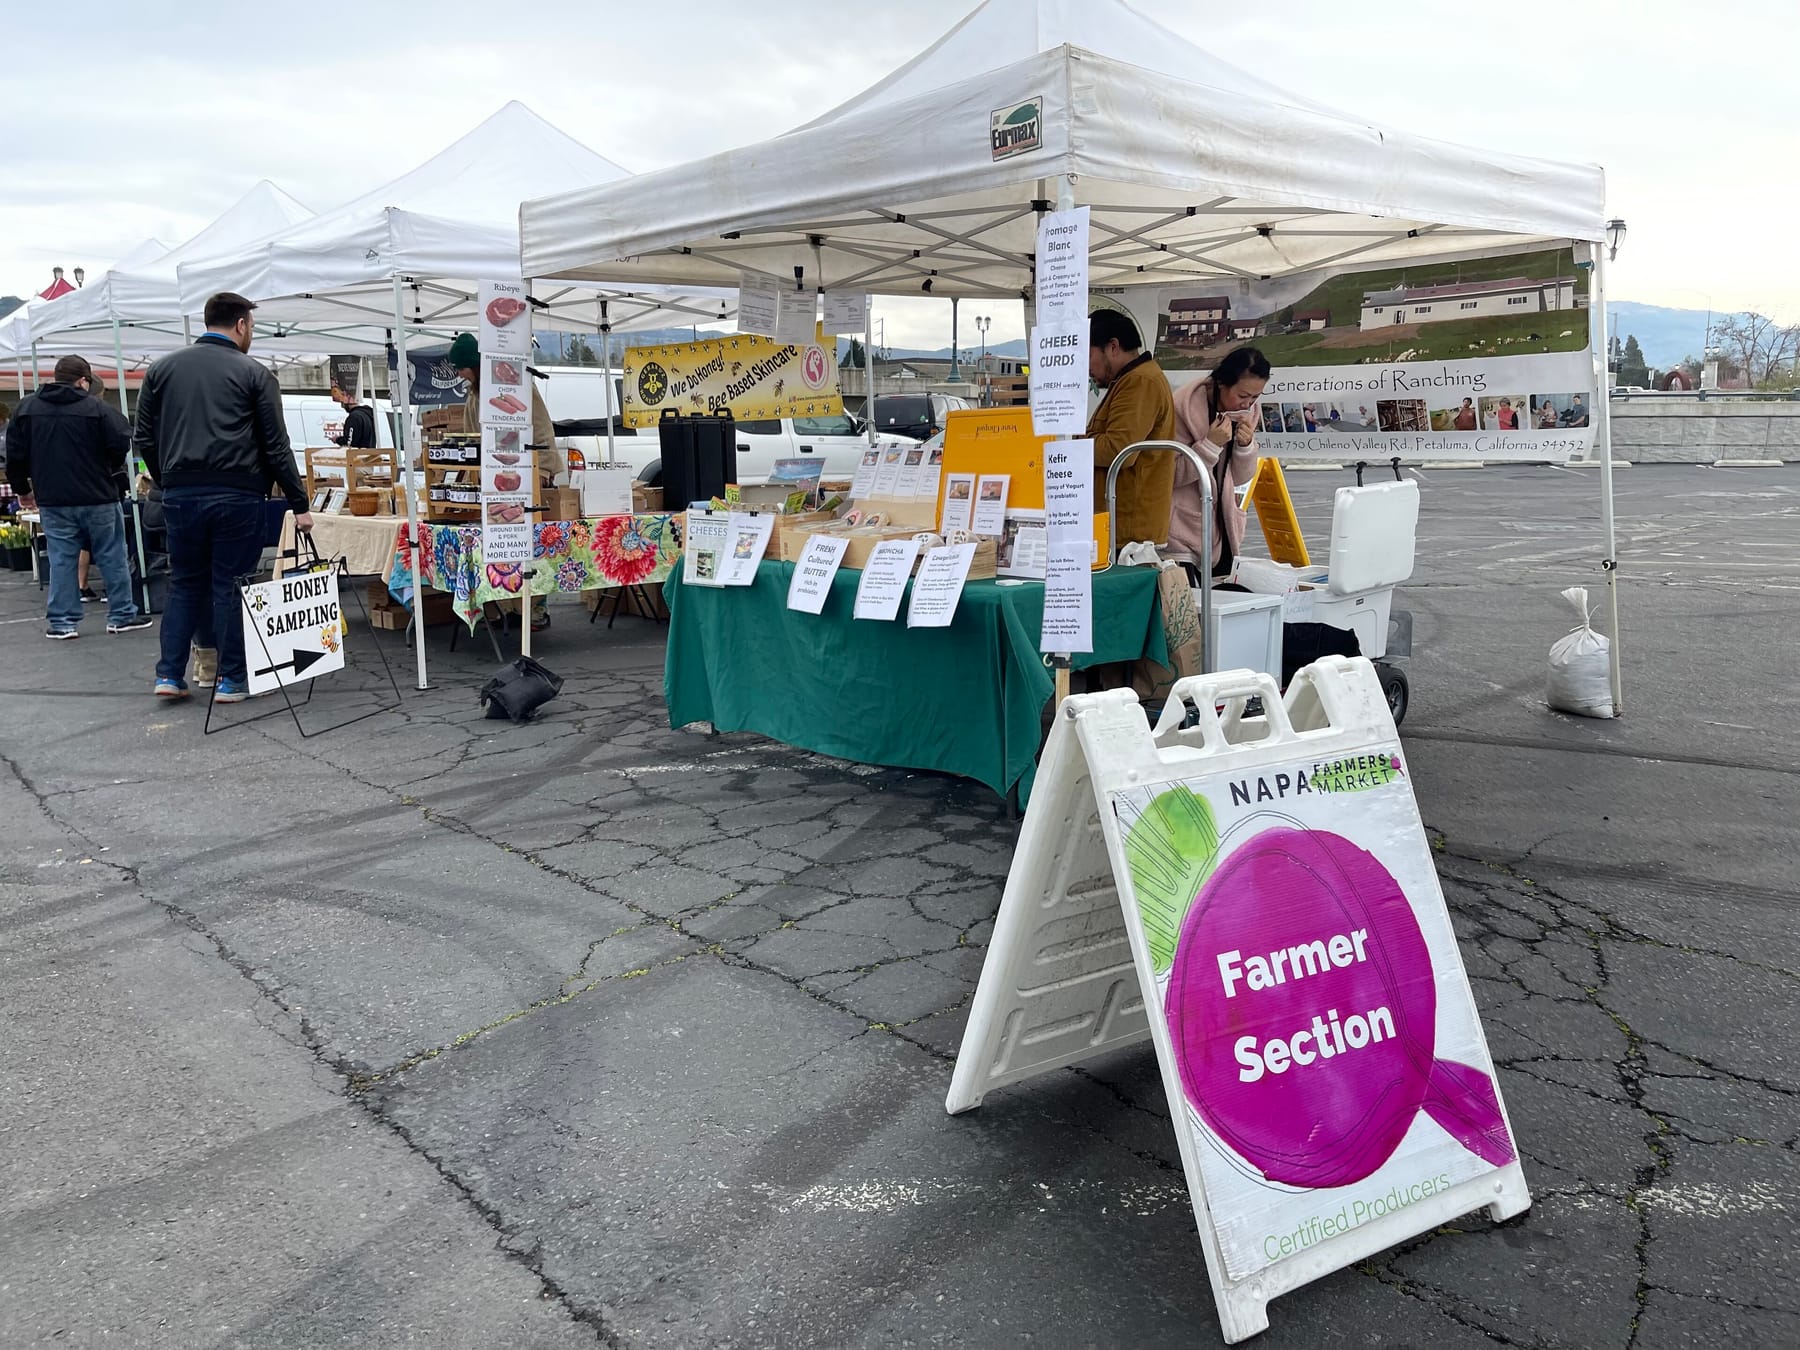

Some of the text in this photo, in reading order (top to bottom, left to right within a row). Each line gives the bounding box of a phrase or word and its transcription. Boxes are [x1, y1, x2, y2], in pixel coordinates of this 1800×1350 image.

[1048, 241, 1071, 252] Blanc
[494, 283, 521, 294] Ribeye
[1039, 334, 1078, 350] CHEESE
[1039, 353, 1075, 368] CURDS
[670, 350, 725, 398] We Do Honey!
[708, 393, 727, 411] Bee
[726, 372, 757, 401] Based
[751, 344, 799, 382] Skincare
[1368, 370, 1388, 389] of
[1393, 367, 1487, 392] Ranching
[1273, 440, 1282, 449] at
[1286, 441, 1306, 451] 750
[1308, 437, 1350, 451] Chileno
[1351, 438, 1387, 453] Valley
[1415, 437, 1472, 452] Petaluma,
[1474, 436, 1538, 451] California
[1542, 440, 1584, 453] 94952
[1048, 454, 1068, 464] Kefir
[1046, 470, 1073, 479] Cheese
[689, 526, 728, 537] CHEESES
[507, 541, 528, 549] MANY
[815, 544, 837, 553] FRESH
[807, 555, 835, 566] Cultured
[803, 567, 828, 577] BUTTER
[282, 575, 329, 603] HONEY
[266, 602, 338, 637] SAMPLING
[1313, 753, 1387, 777] FARMERS
[1229, 770, 1312, 806] NAPA
[1316, 769, 1391, 795] MARKET
[1216, 928, 1368, 998] Farmer
[1233, 1006, 1396, 1082] Section
[1263, 1173, 1450, 1261] Certified Producers
